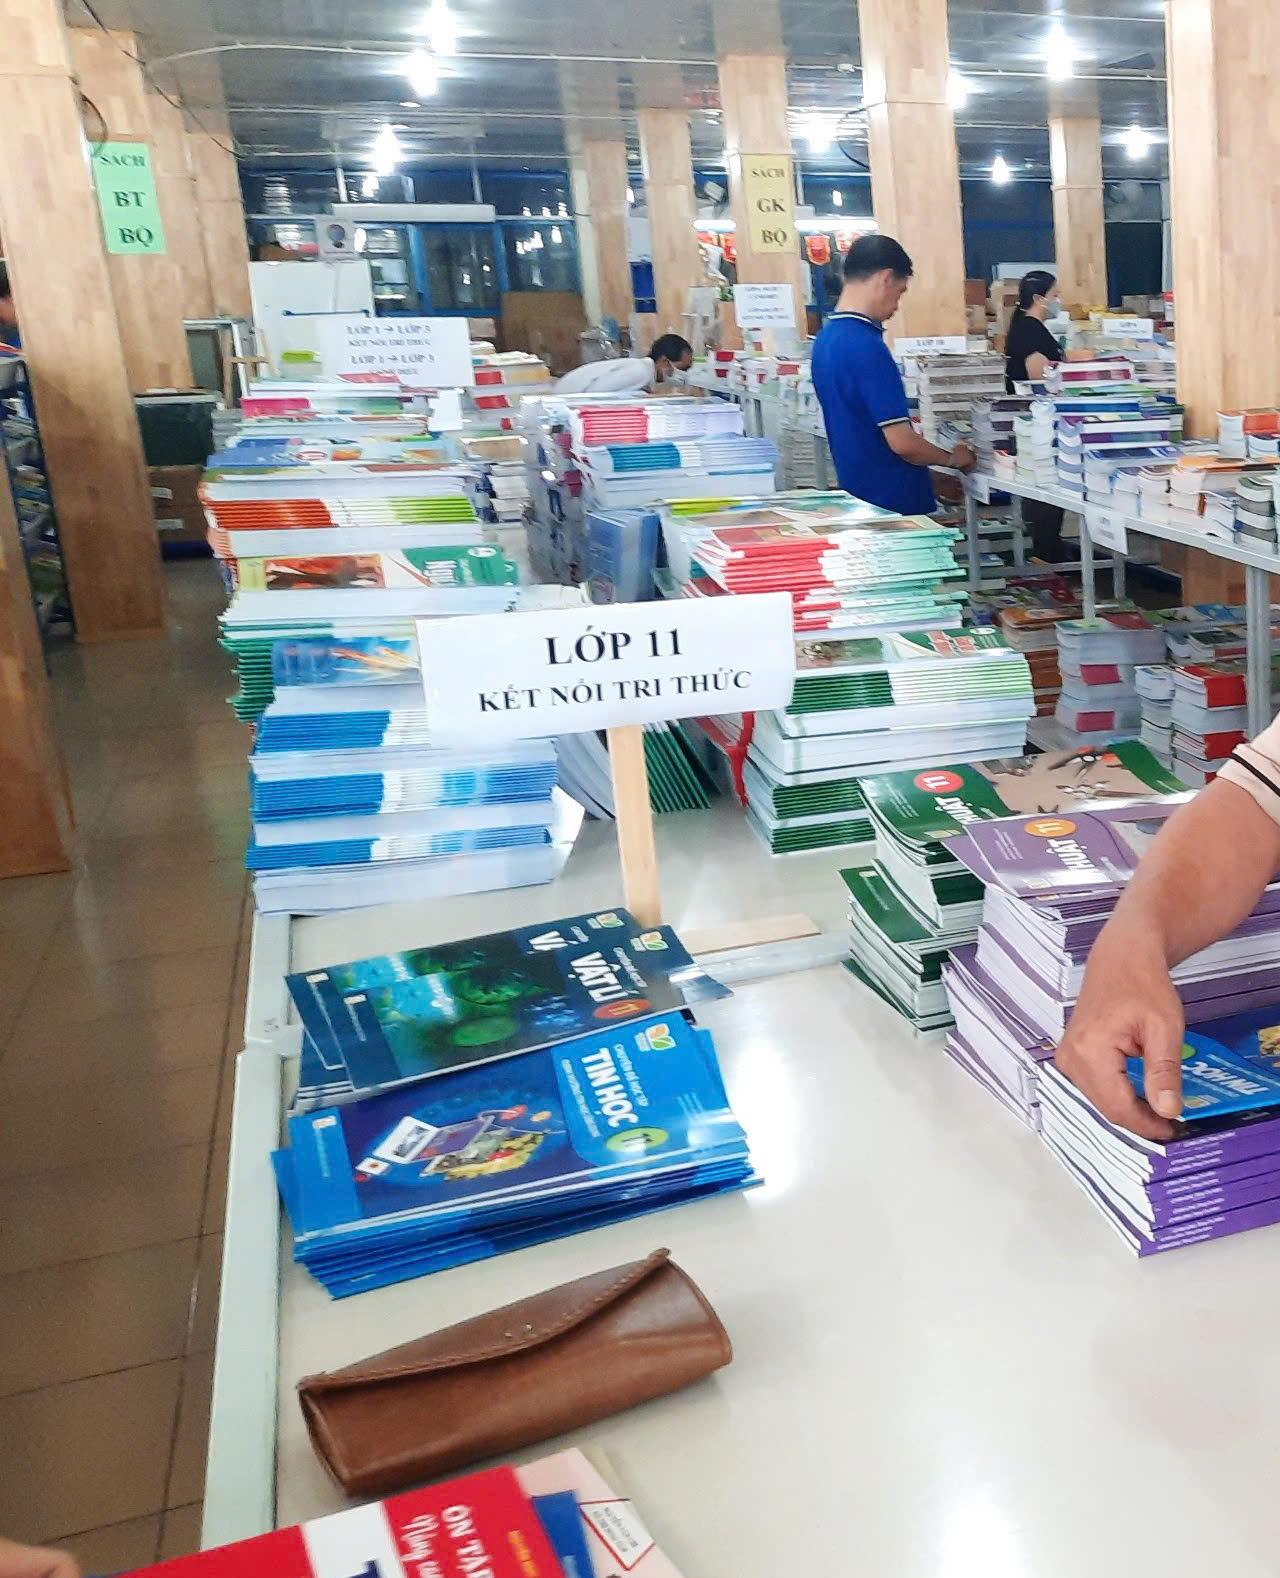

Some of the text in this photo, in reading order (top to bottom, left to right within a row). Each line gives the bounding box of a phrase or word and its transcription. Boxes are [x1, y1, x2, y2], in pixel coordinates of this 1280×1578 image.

[112, 191, 146, 208] BT
[756, 198, 785, 213] GK
[544, 624, 684, 666] LỚP 11
[479, 667, 753, 714] KẾT NỐI TRI THỨC
[923, 775, 951, 790] 11
[1034, 821, 1067, 834] 11
[567, 951, 622, 988] VẬT
[581, 1047, 621, 1088] TIN
[592, 1083, 640, 1128] HỌC
